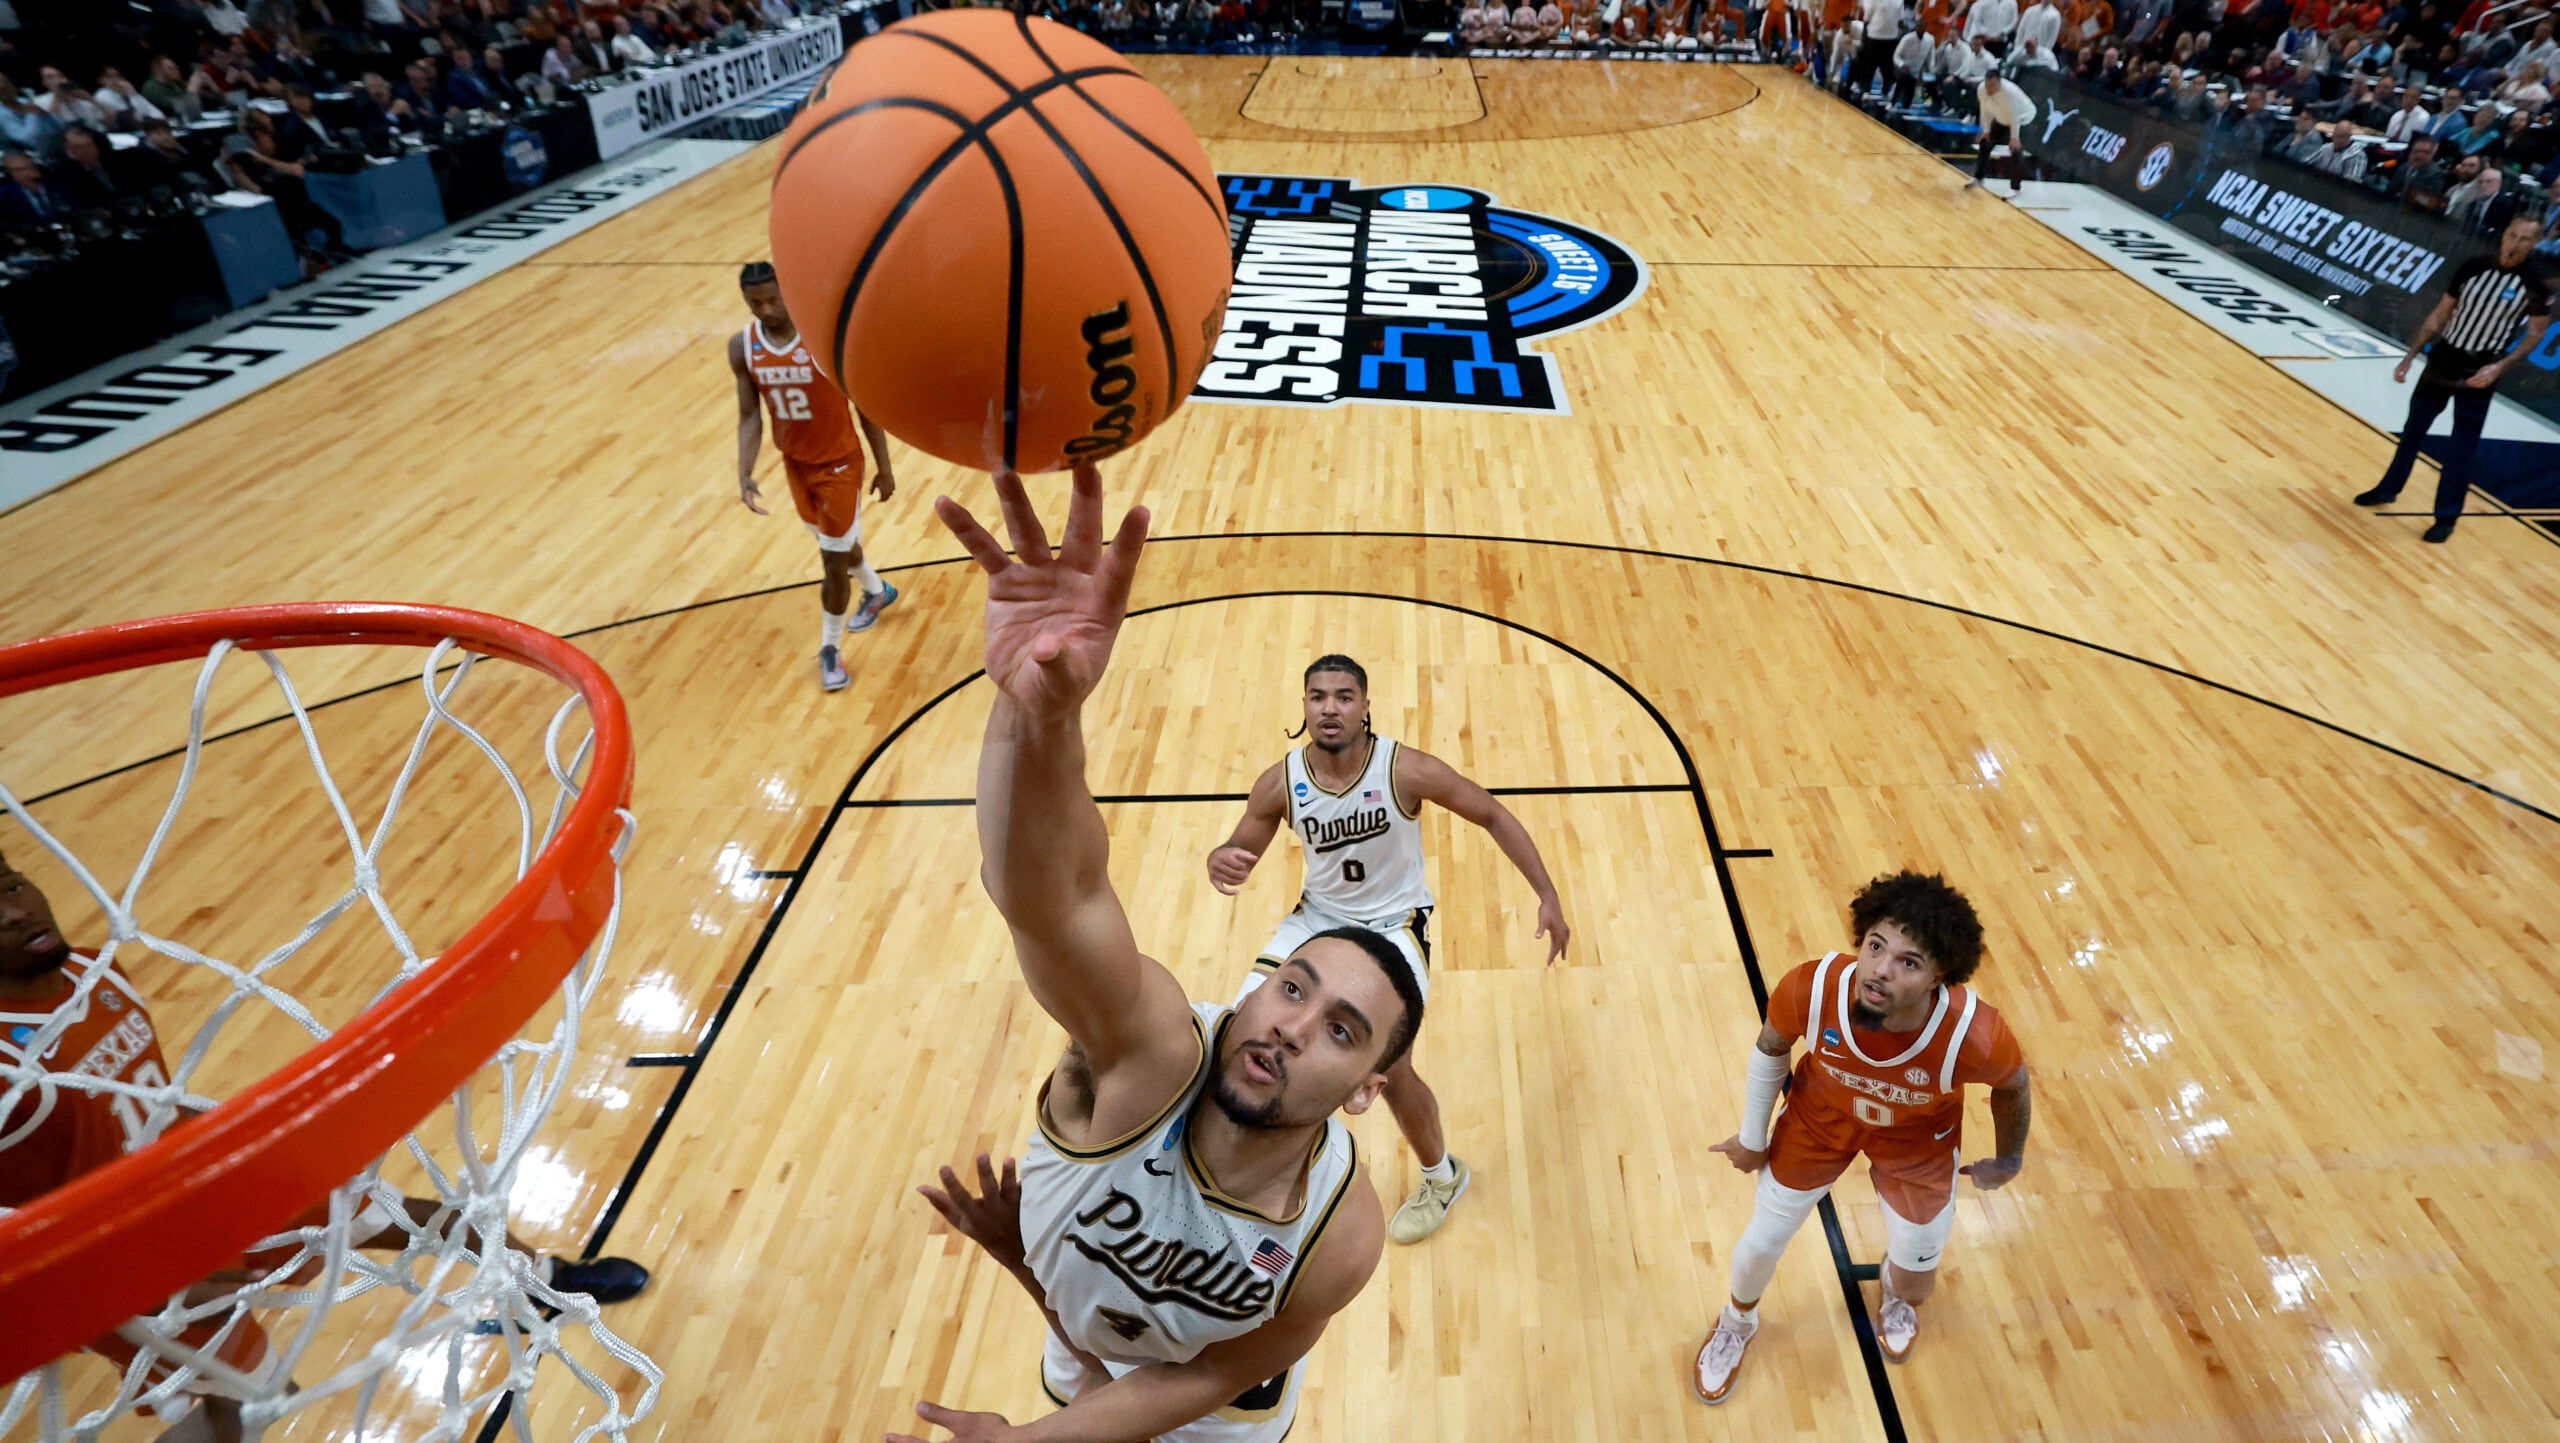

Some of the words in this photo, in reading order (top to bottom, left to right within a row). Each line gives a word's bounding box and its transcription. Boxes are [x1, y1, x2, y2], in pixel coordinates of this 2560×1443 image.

[636, 80, 675, 132] SAN
[680, 65, 722, 117] JOSE
[724, 50, 768, 98] STATE
[768, 26, 837, 81] UNIVERSITY
[2081, 125, 2127, 163] TEXAS
[2138, 146, 2172, 187] SEC
[453, 190, 624, 240] ROAD
[2206, 169, 2269, 218] NCAA
[2256, 190, 2344, 248] SWEET
[2325, 220, 2446, 295] SIXTEEN
[1361, 209, 1489, 321] MARCH
[1527, 233, 1599, 272] SWEET
[2292, 251, 2324, 273] STATE
[2316, 262, 2374, 297] UNIVERSITY
[226, 259, 473, 334] FINAL
[1551, 273, 1598, 291] 16
[2081, 226, 2204, 265] SAN
[2151, 267, 2322, 329] JOSE
[1196, 218, 1357, 397] MADNESS
[0, 344, 287, 453] FOUR
[754, 366, 813, 386] TEXAS
[769, 387, 813, 420] 12
[1301, 807, 1390, 848] Purdue
[1342, 859, 1366, 883] 0
[68, 1008, 155, 1099] TEXAS
[1819, 1060, 1934, 1106] TEXAS
[1853, 1096, 1895, 1128] 0
[1074, 1184, 1276, 1314] Purdue
[1095, 1304, 1152, 1343] 4
